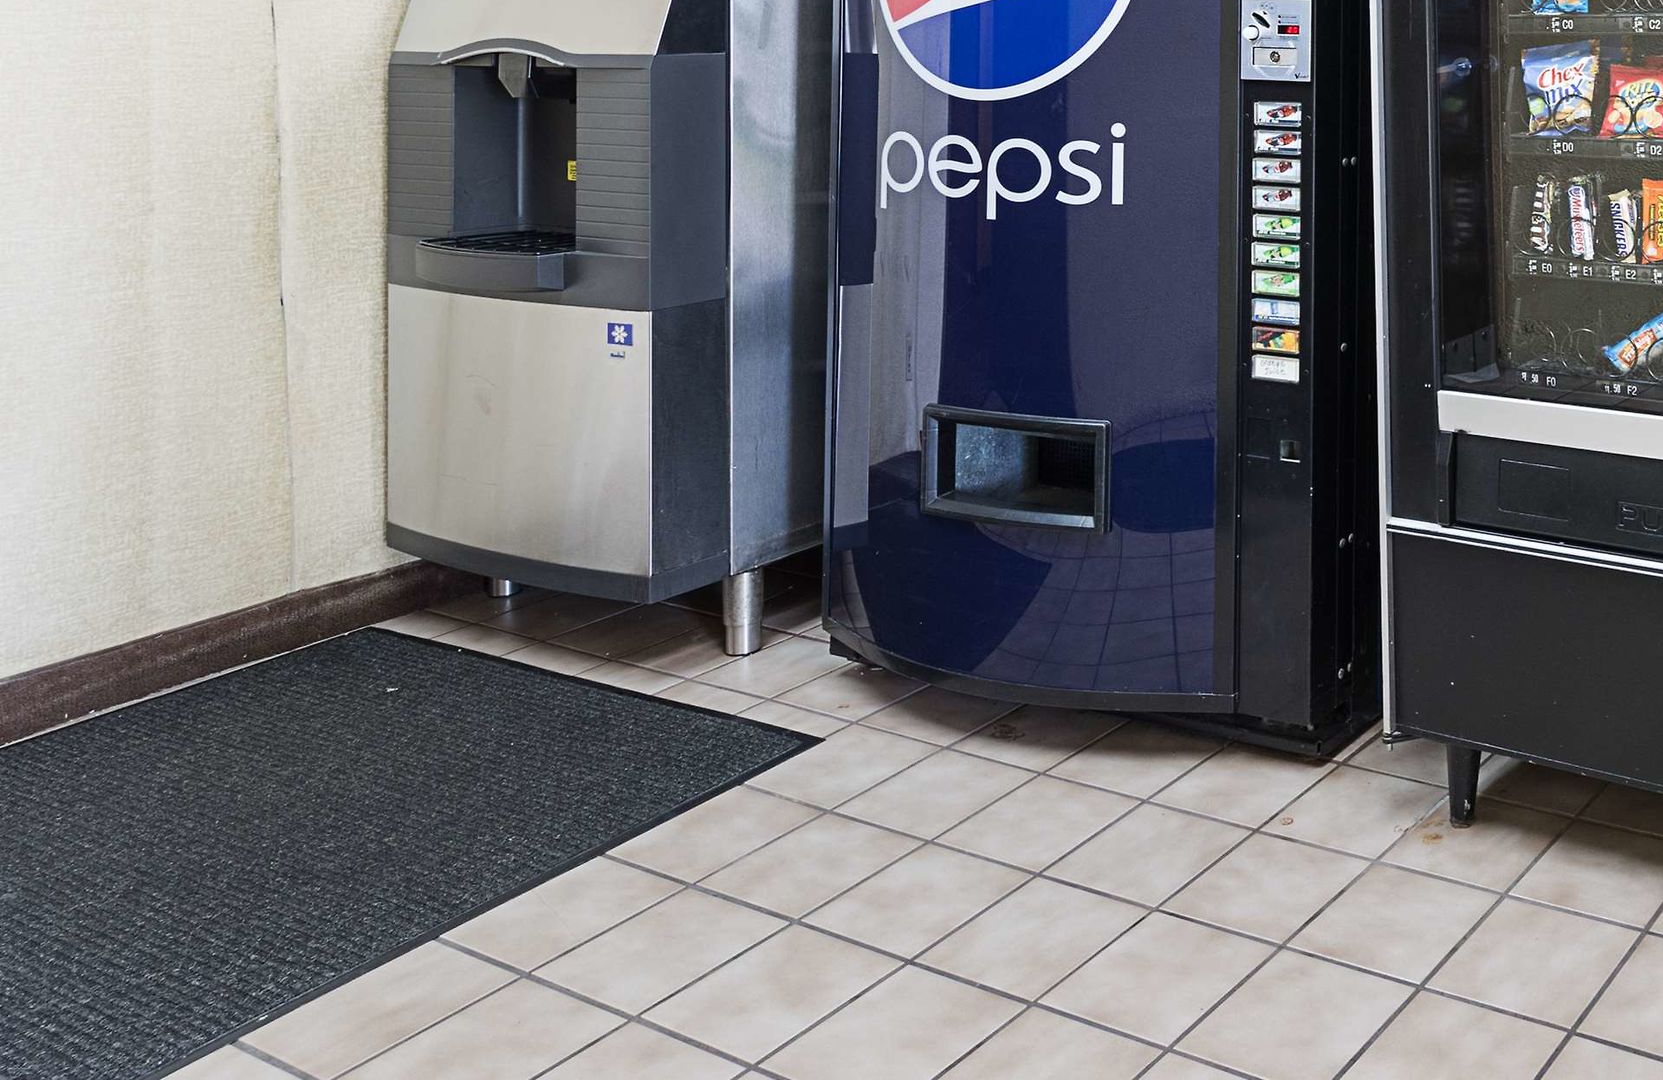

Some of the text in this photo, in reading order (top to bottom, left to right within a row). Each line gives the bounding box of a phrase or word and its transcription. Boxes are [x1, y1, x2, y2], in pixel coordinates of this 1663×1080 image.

[1649, 20, 1661, 30] C2
[1538, 63, 1585, 89] Chex
[880, 122, 1127, 220] pepsi
[1583, 266, 1593, 276] E1
[1625, 270, 1636, 279] E2
[1627, 386, 1637, 396] F2
